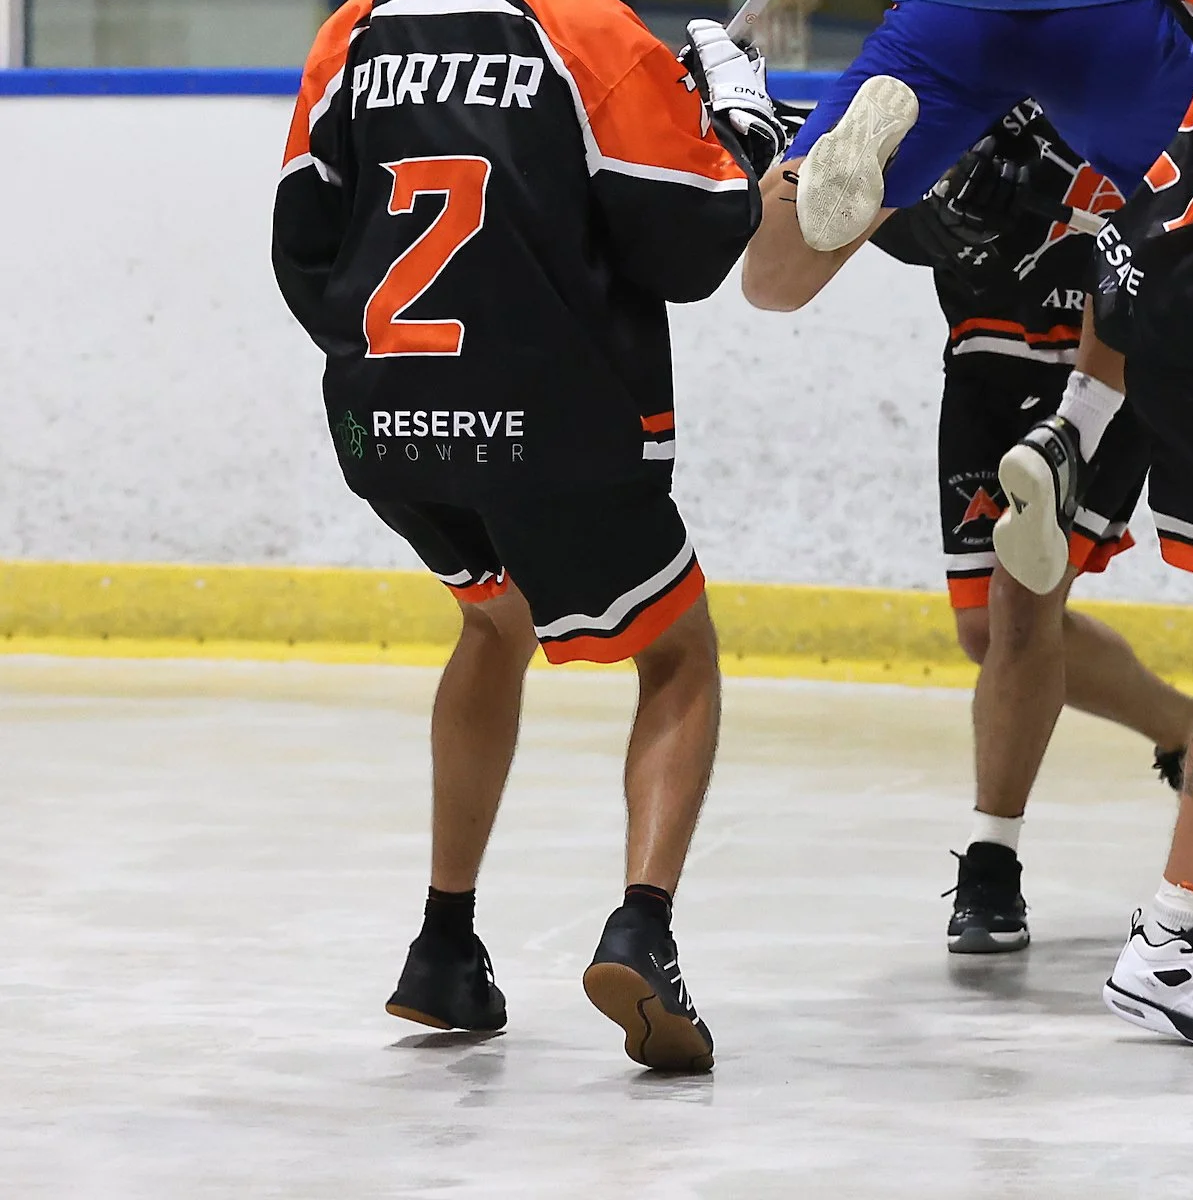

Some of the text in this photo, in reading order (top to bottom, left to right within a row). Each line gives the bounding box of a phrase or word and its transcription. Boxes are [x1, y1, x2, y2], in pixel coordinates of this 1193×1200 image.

[351, 53, 545, 120] PORTER
[363, 154, 492, 359] 2
[372, 410, 525, 438] RESERVE
[375, 443, 525, 463] POWER
